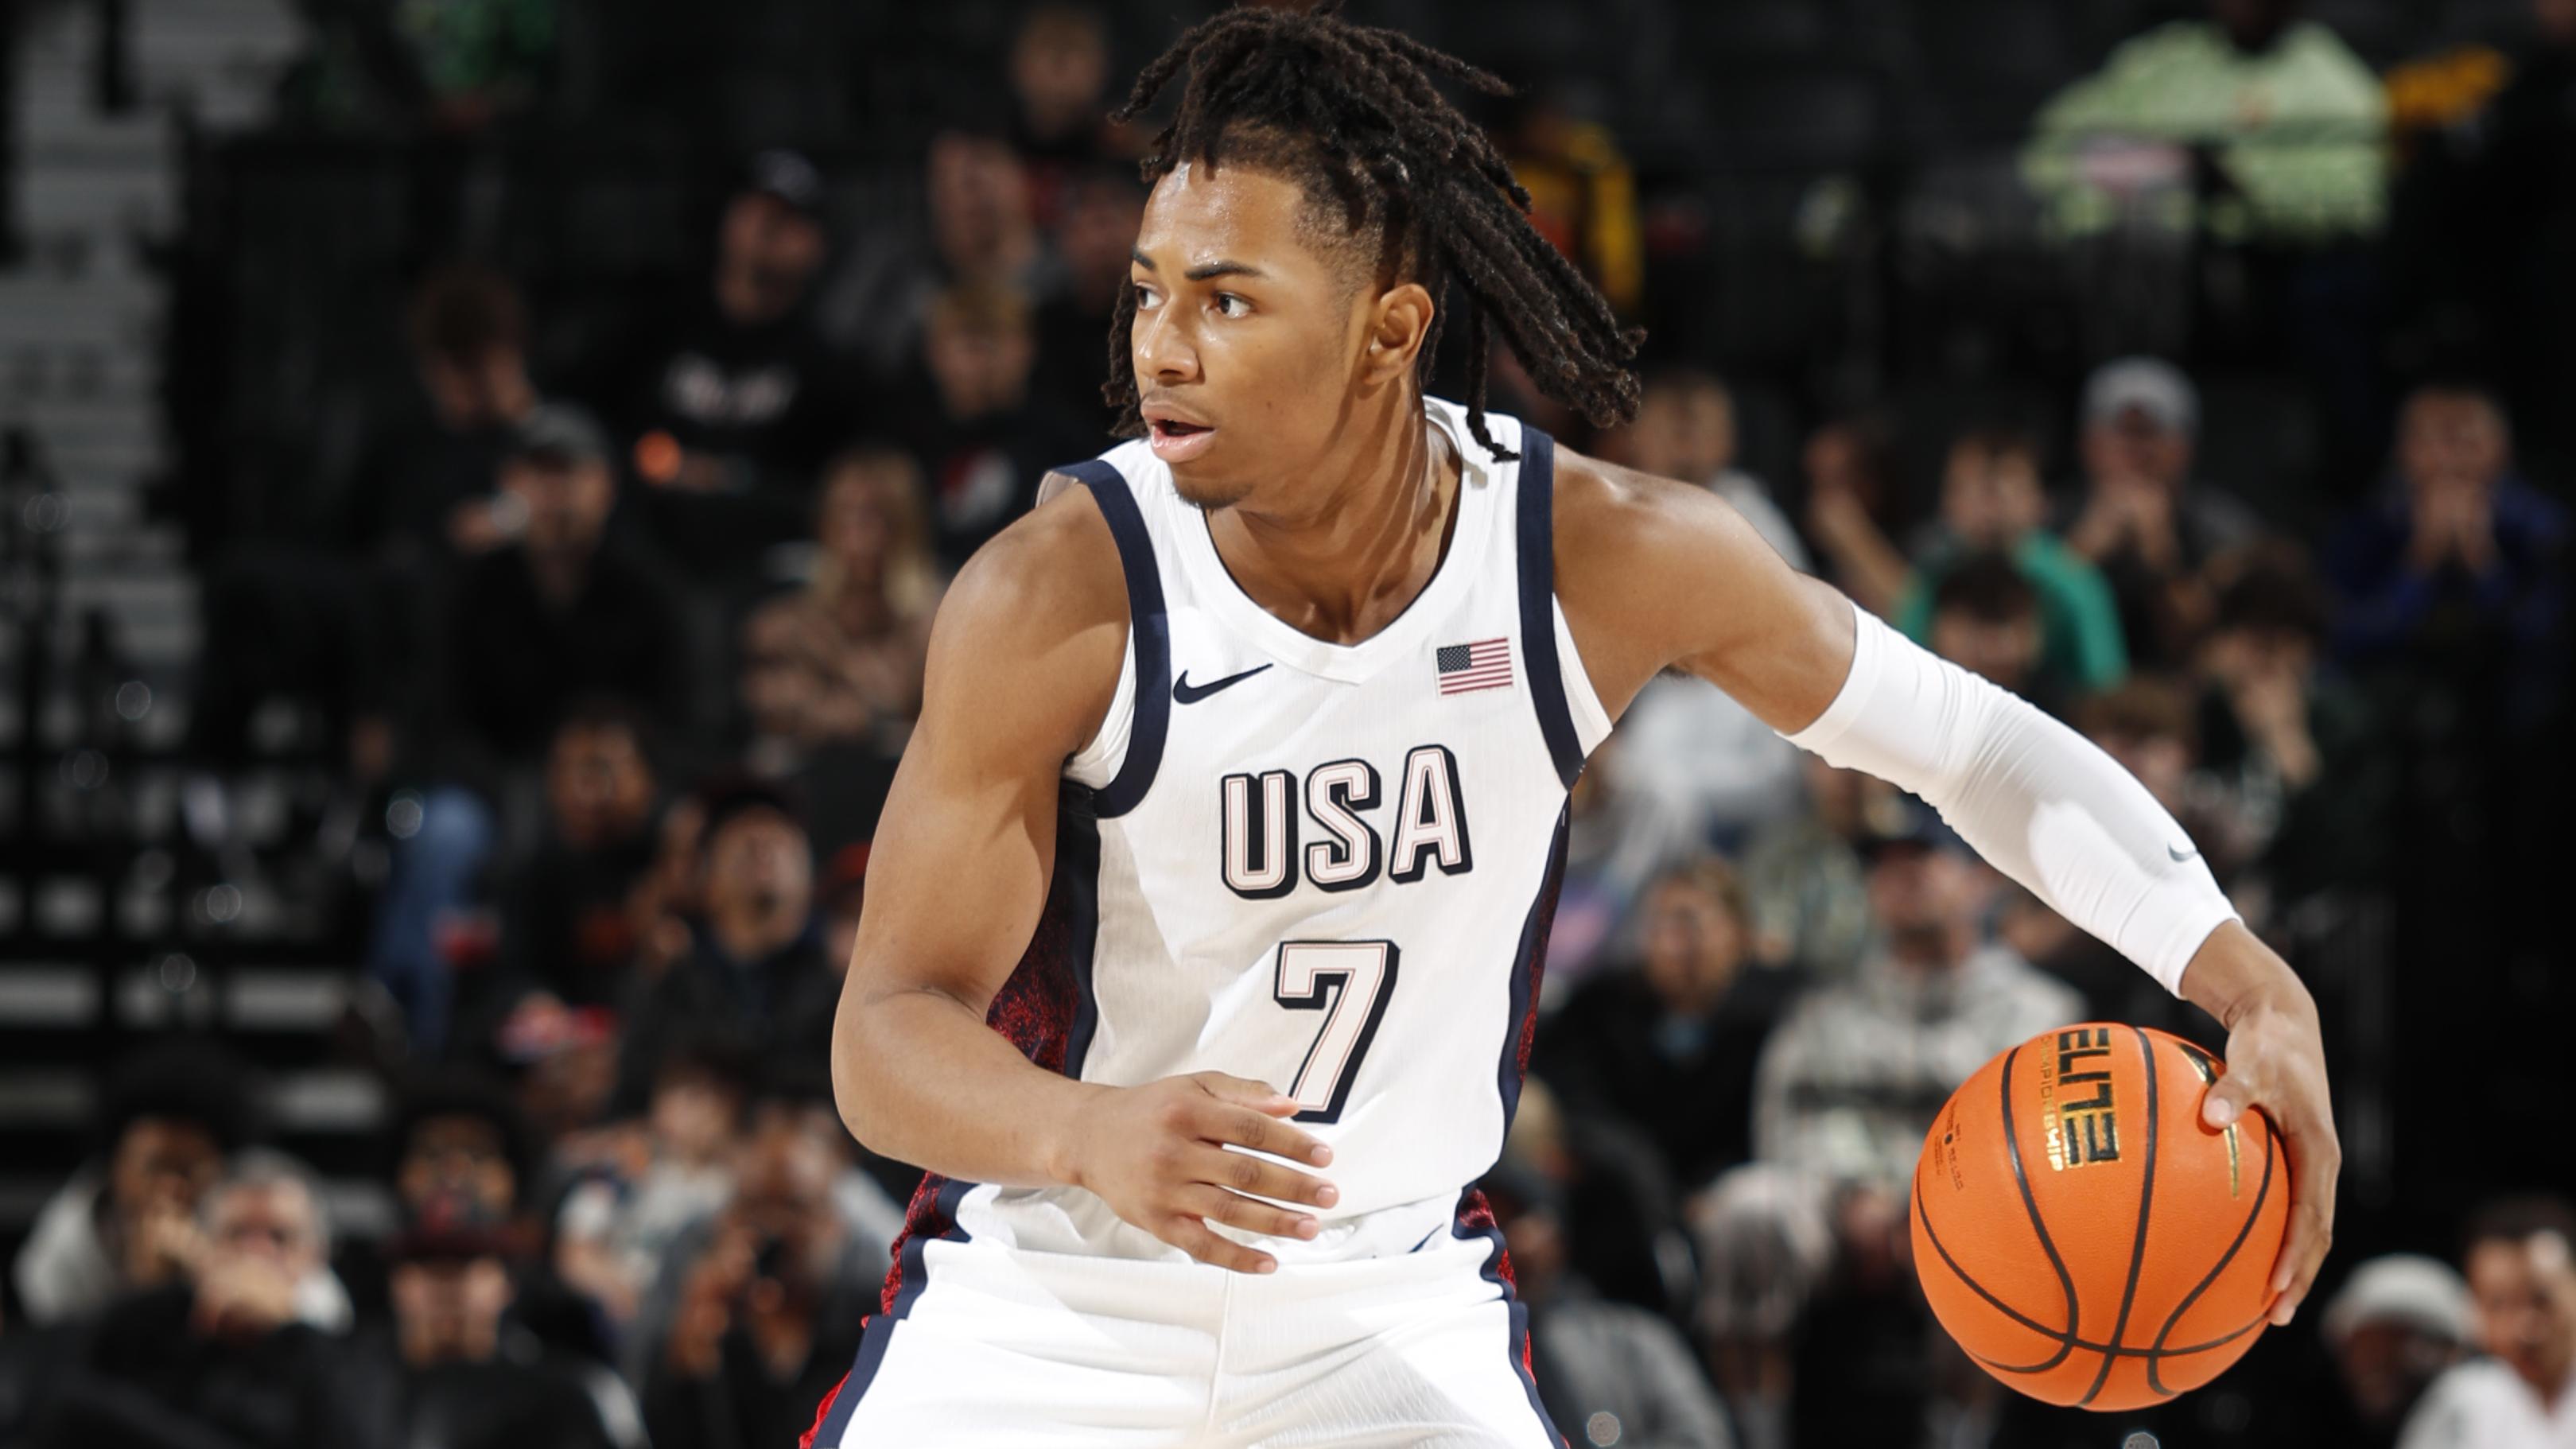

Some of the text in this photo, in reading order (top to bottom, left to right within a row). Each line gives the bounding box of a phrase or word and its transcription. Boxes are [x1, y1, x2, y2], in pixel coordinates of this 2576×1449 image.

[1221, 744, 1473, 900] USA
[1273, 939, 1401, 1125] 7
[2058, 1028, 2122, 1168] ELITE
